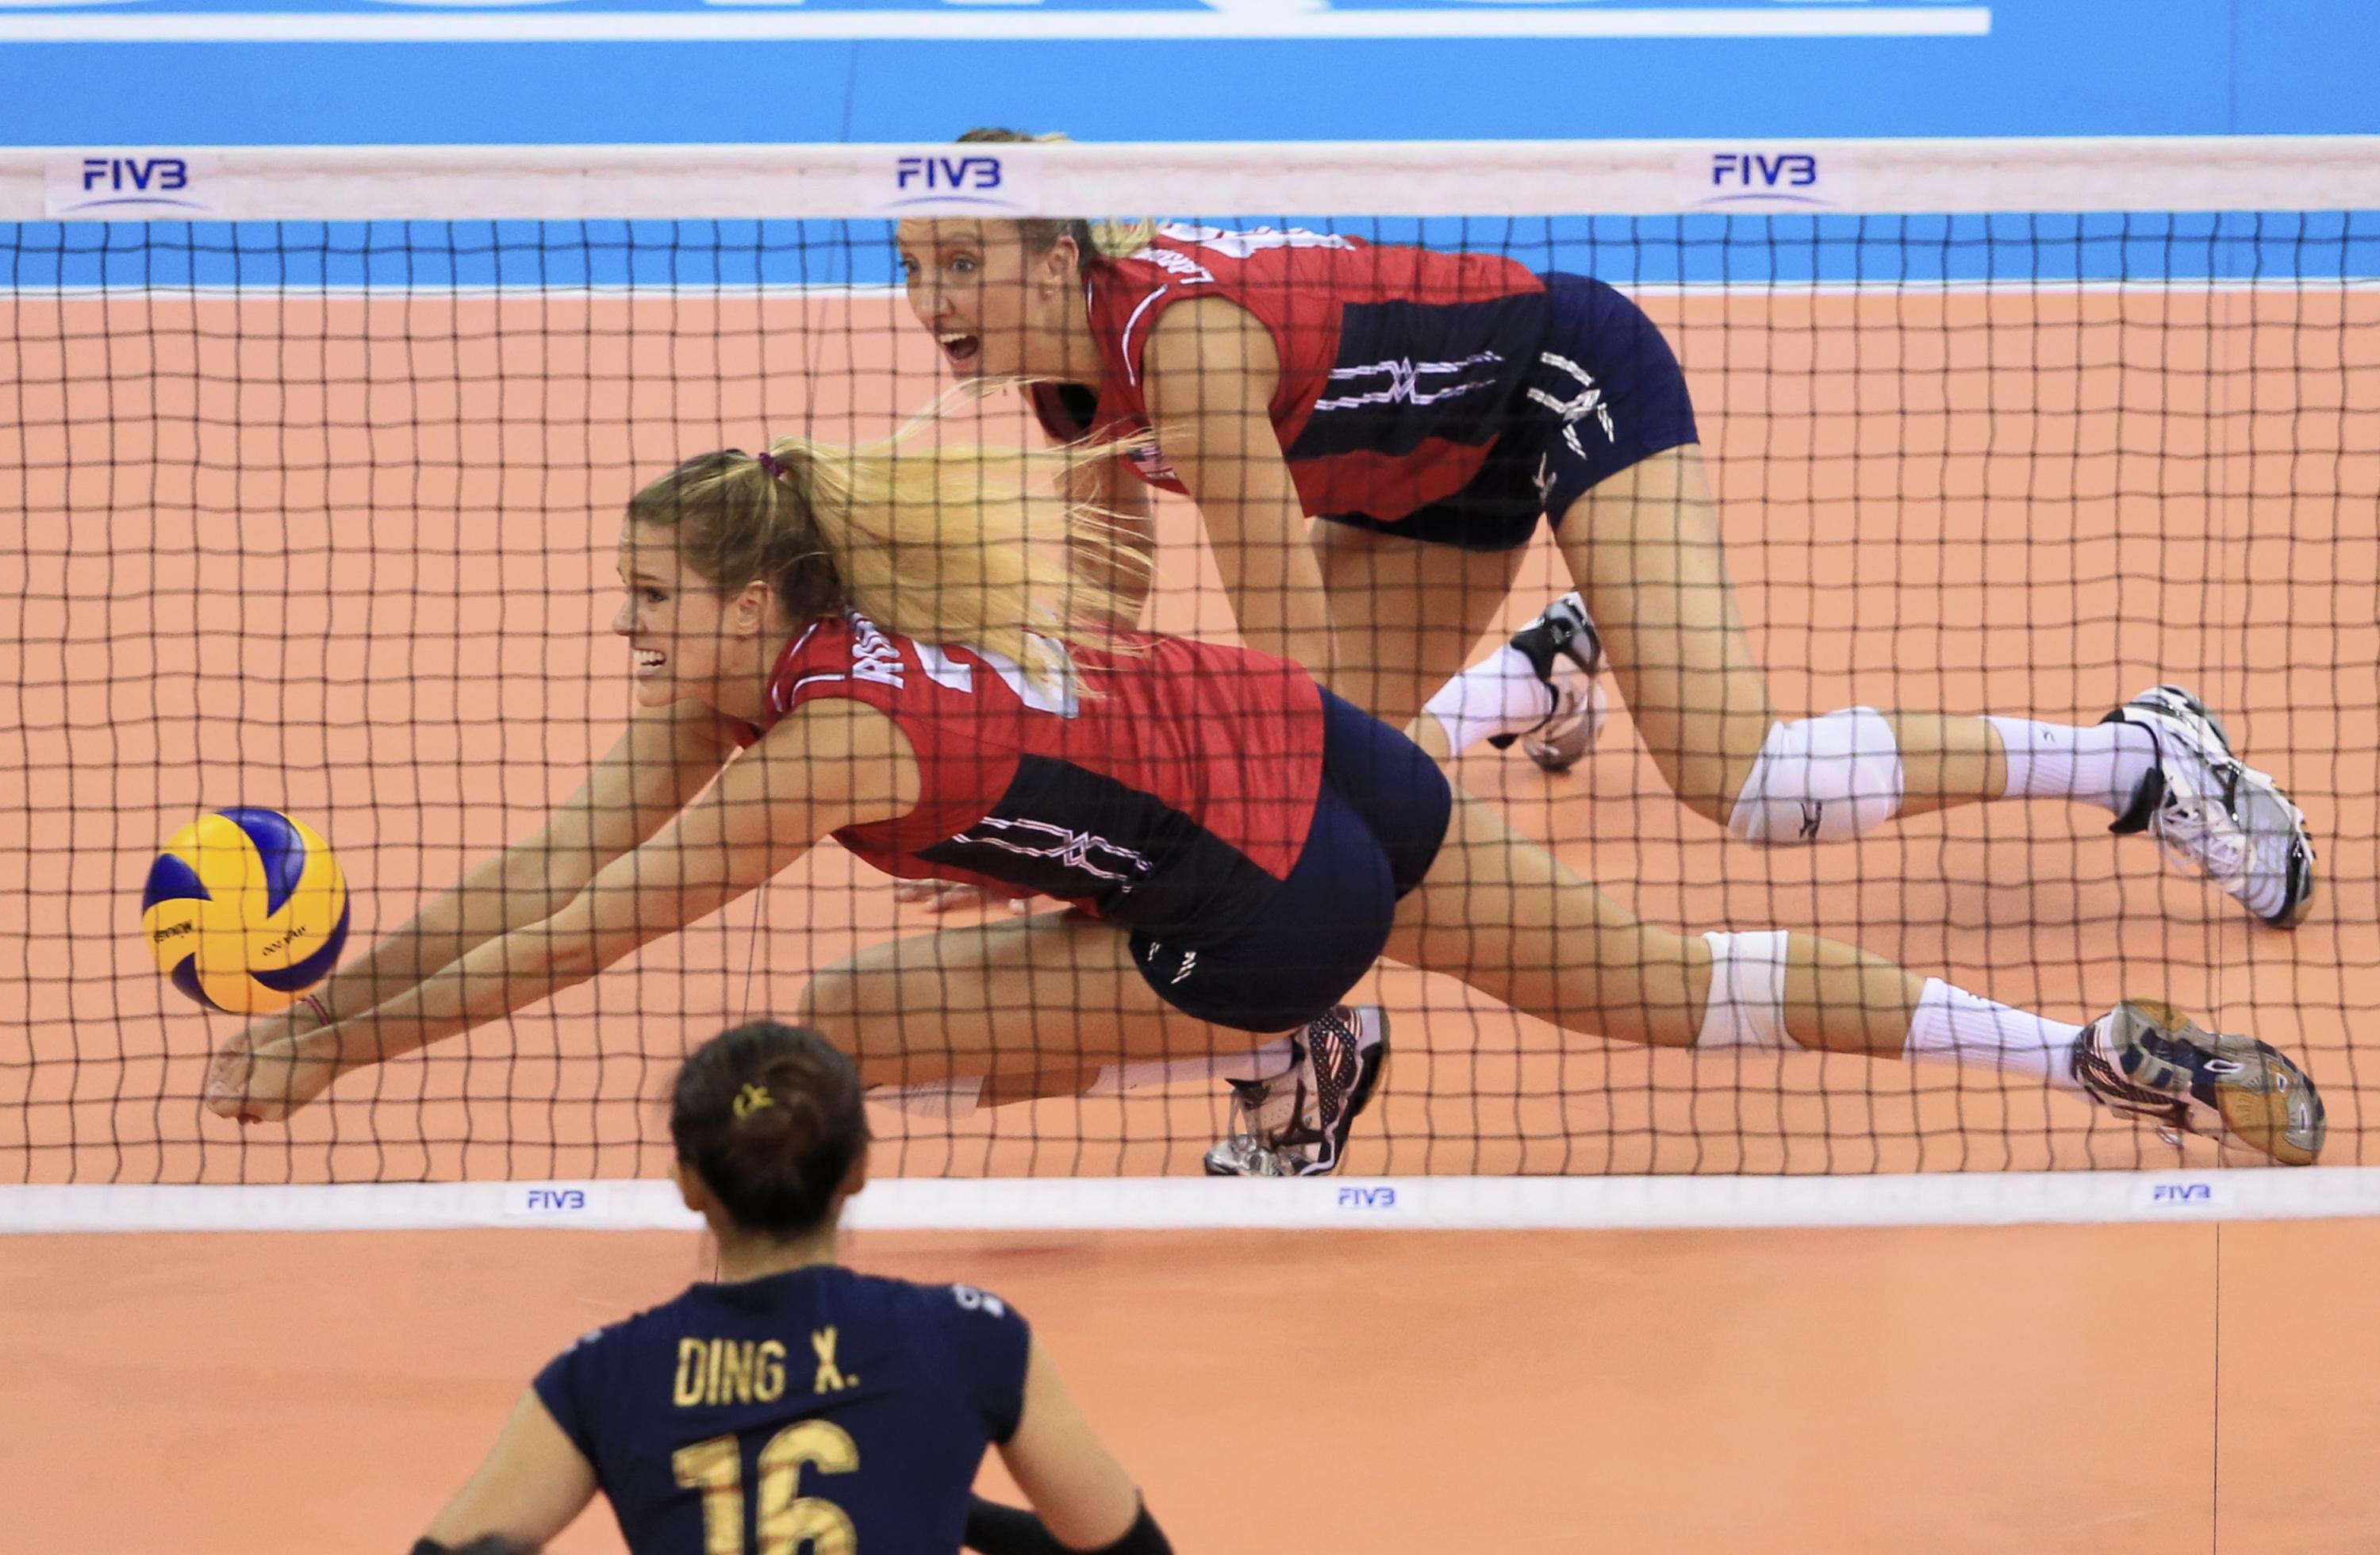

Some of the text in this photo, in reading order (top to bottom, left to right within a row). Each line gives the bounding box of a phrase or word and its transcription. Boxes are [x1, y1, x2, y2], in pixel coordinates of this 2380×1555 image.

[83, 157, 188, 191] FIVB
[896, 156, 1002, 189] FIVB
[1711, 153, 1817, 186] FIVB
[528, 1189, 585, 1209] FIVB
[1338, 1187, 1395, 1207] FIVB
[673, 1323, 861, 1406] DING X.
[671, 1419, 860, 1555] 16
